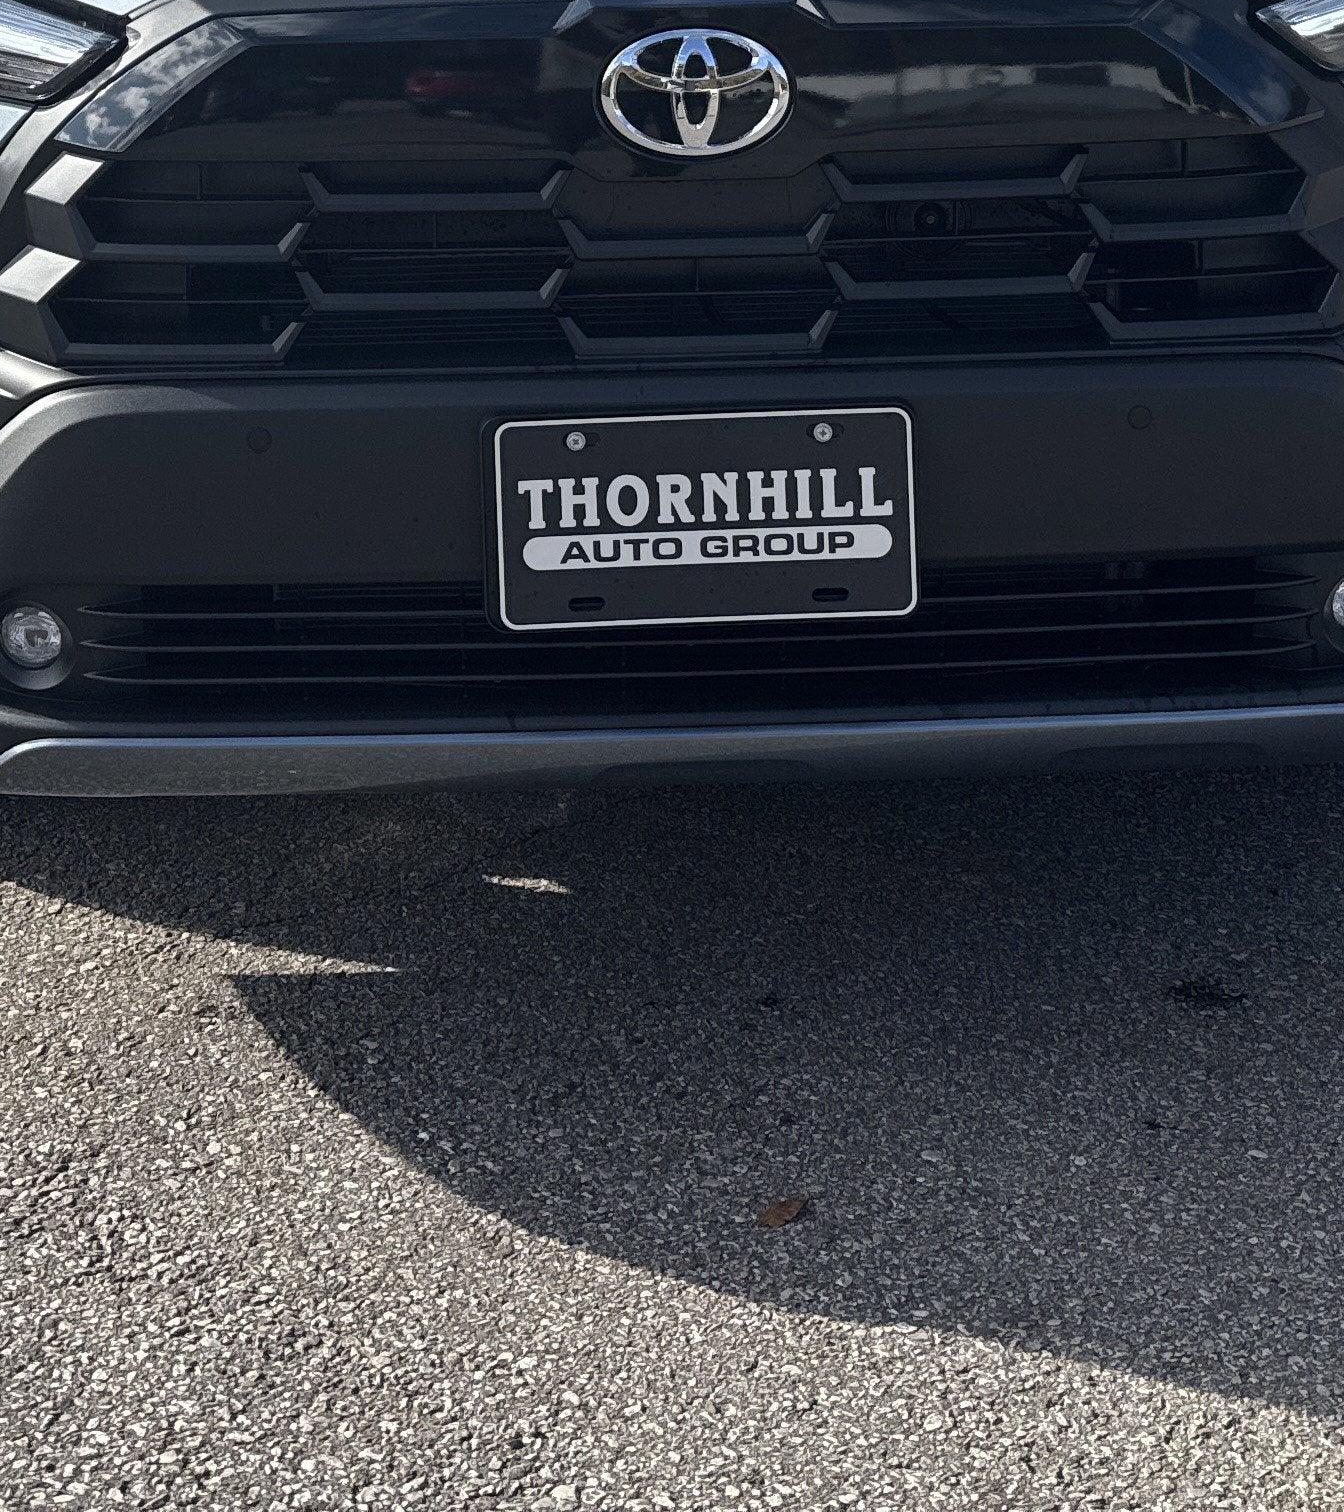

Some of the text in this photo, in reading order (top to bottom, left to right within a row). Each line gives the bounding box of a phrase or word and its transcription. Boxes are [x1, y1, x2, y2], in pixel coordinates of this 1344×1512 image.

[517, 466, 893, 530] THORNHILL
[560, 531, 855, 565] AUTO GROUP
